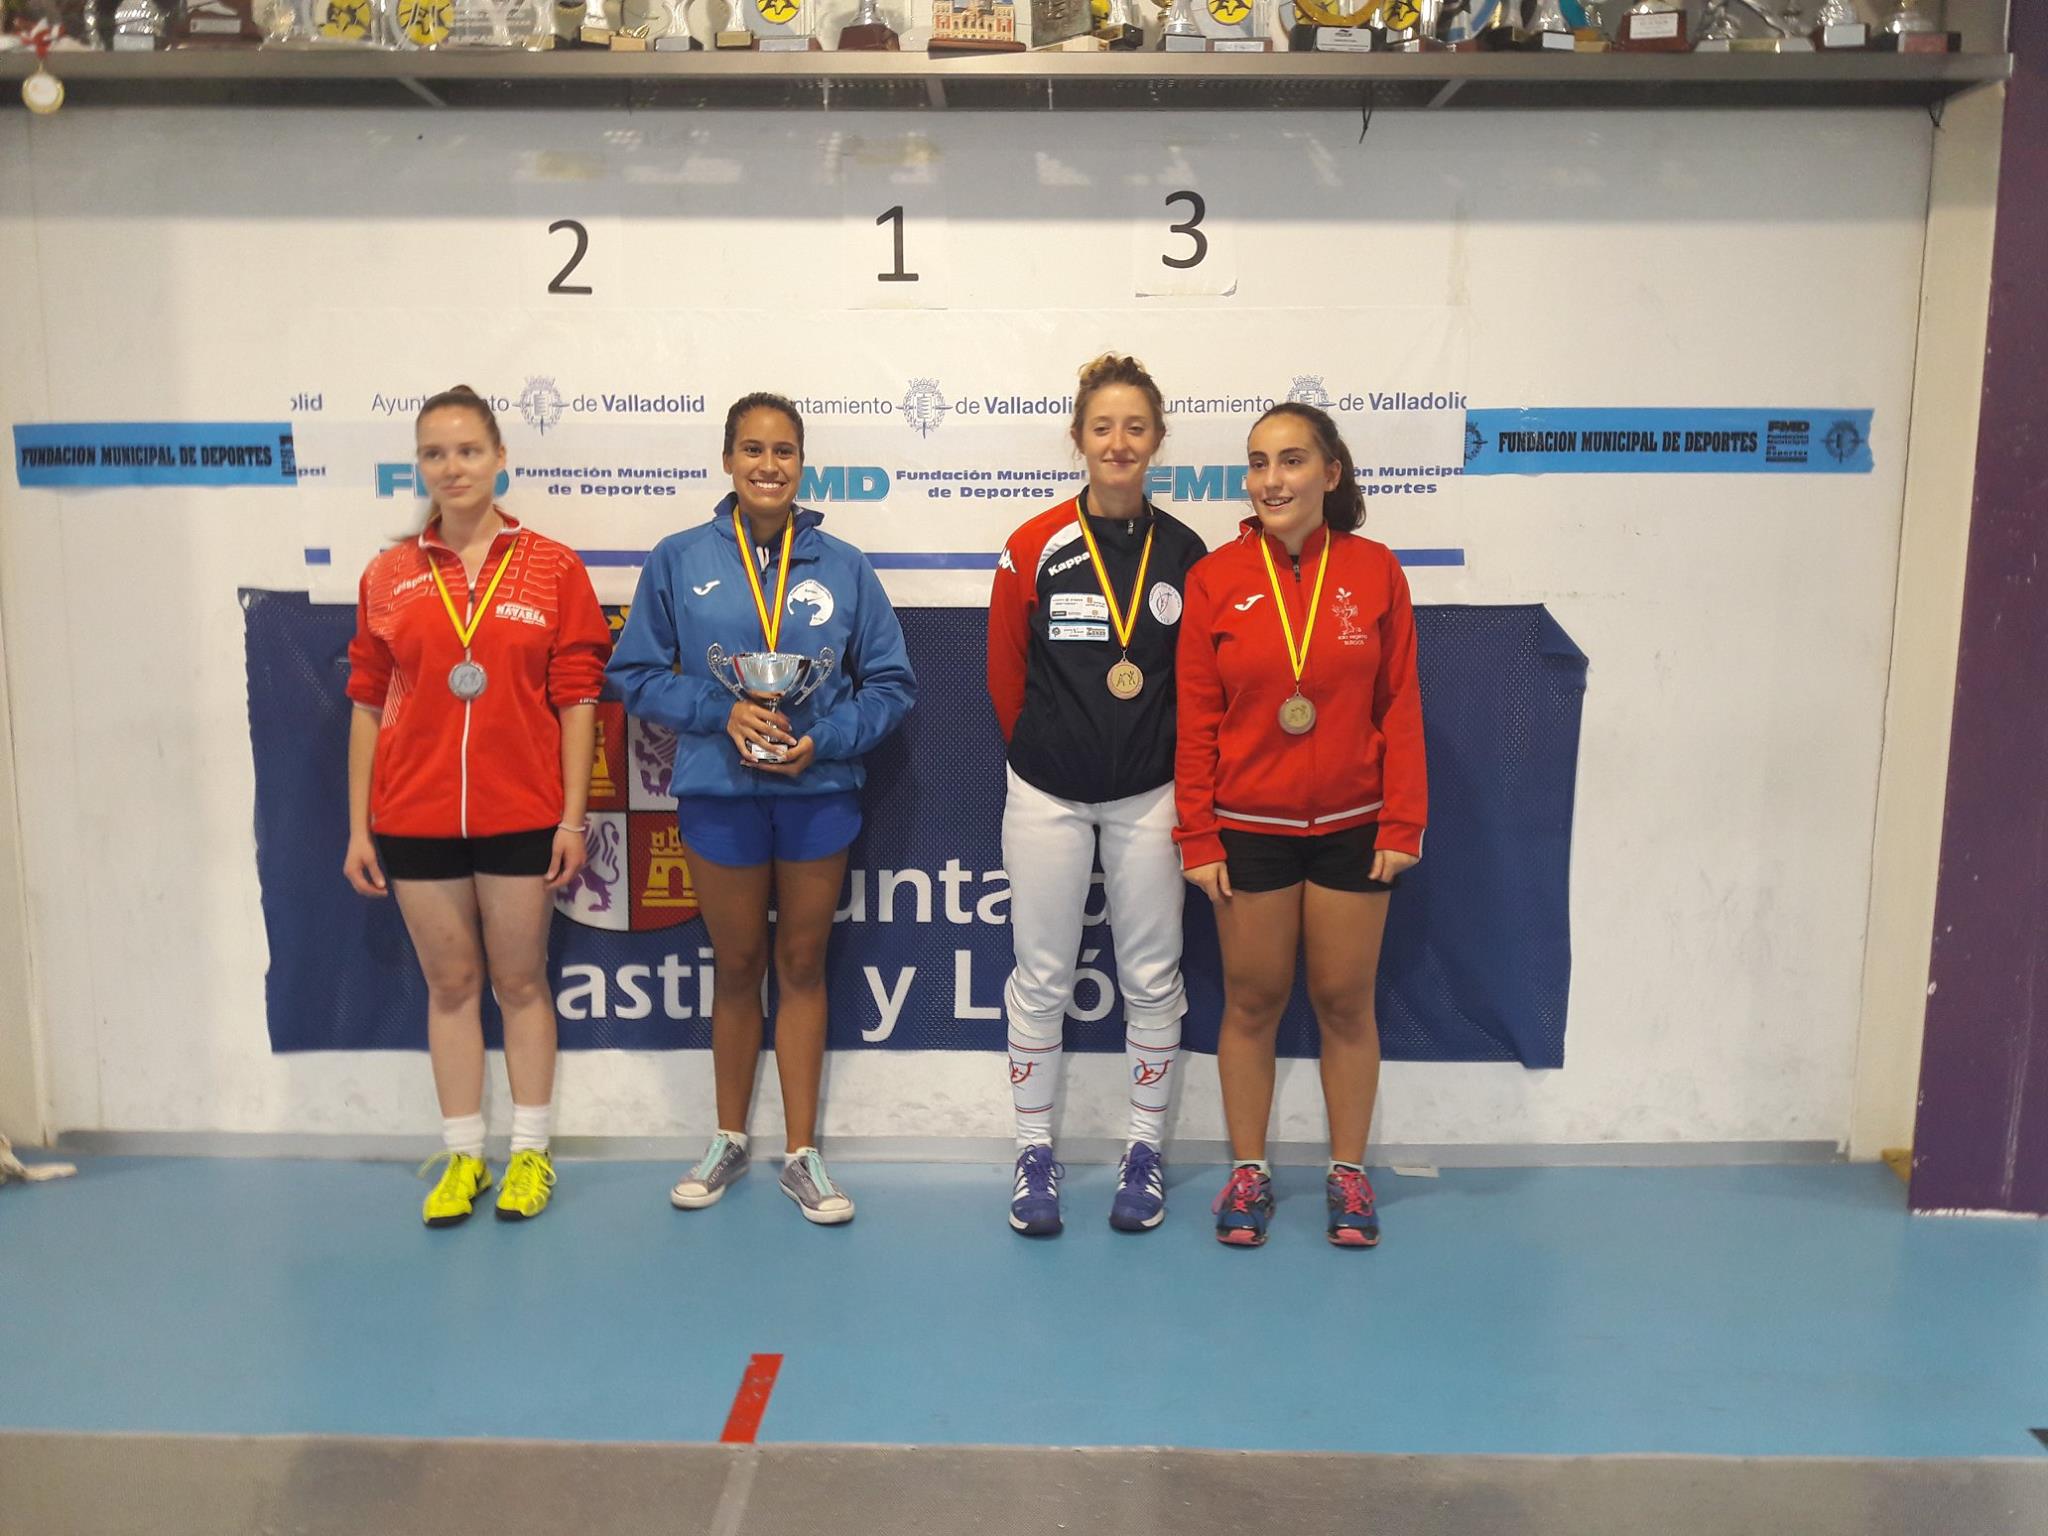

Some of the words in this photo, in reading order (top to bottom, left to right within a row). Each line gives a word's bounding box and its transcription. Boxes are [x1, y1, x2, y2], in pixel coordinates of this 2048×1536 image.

[1162, 190, 1208, 268] 3
[876, 205, 919, 282] 1
[548, 219, 593, 295] 2
[572, 394, 597, 413] de
[601, 394, 705, 413] Valladolid
[794, 397, 892, 415] ntamiento
[955, 397, 980, 415] de
[984, 396, 1073, 415] Valladoli
[1162, 395, 1276, 414] untamiento
[1339, 393, 1364, 411] de
[1499, 431, 1577, 452] FUNDACION
[1581, 431, 1657, 452] MUNICIPAL
[1662, 431, 1681, 452] DE
[1684, 431, 1758, 452] DEPORTES
[22, 447, 96, 467] FUNDACION
[100, 446, 175, 466] MUNICIPAL
[180, 446, 197, 466] DE
[201, 446, 272, 466] DEPORTES
[515, 467, 612, 478] Fundación
[617, 468, 707, 480] Municipal
[896, 470, 992, 480] Fundación
[997, 470, 1086, 481] Municipal
[1379, 466, 1464, 477] Municipa
[548, 484, 572, 495] de
[580, 484, 676, 496] Deportes
[796, 466, 891, 502] MD
[928, 487, 951, 498] de
[960, 487, 1055, 499] Deportes
[1360, 483, 1437, 496] eportes
[1048, 552, 1091, 576] Kappa
[834, 858, 1012, 925] unta
[861, 966, 918, 1042] y
